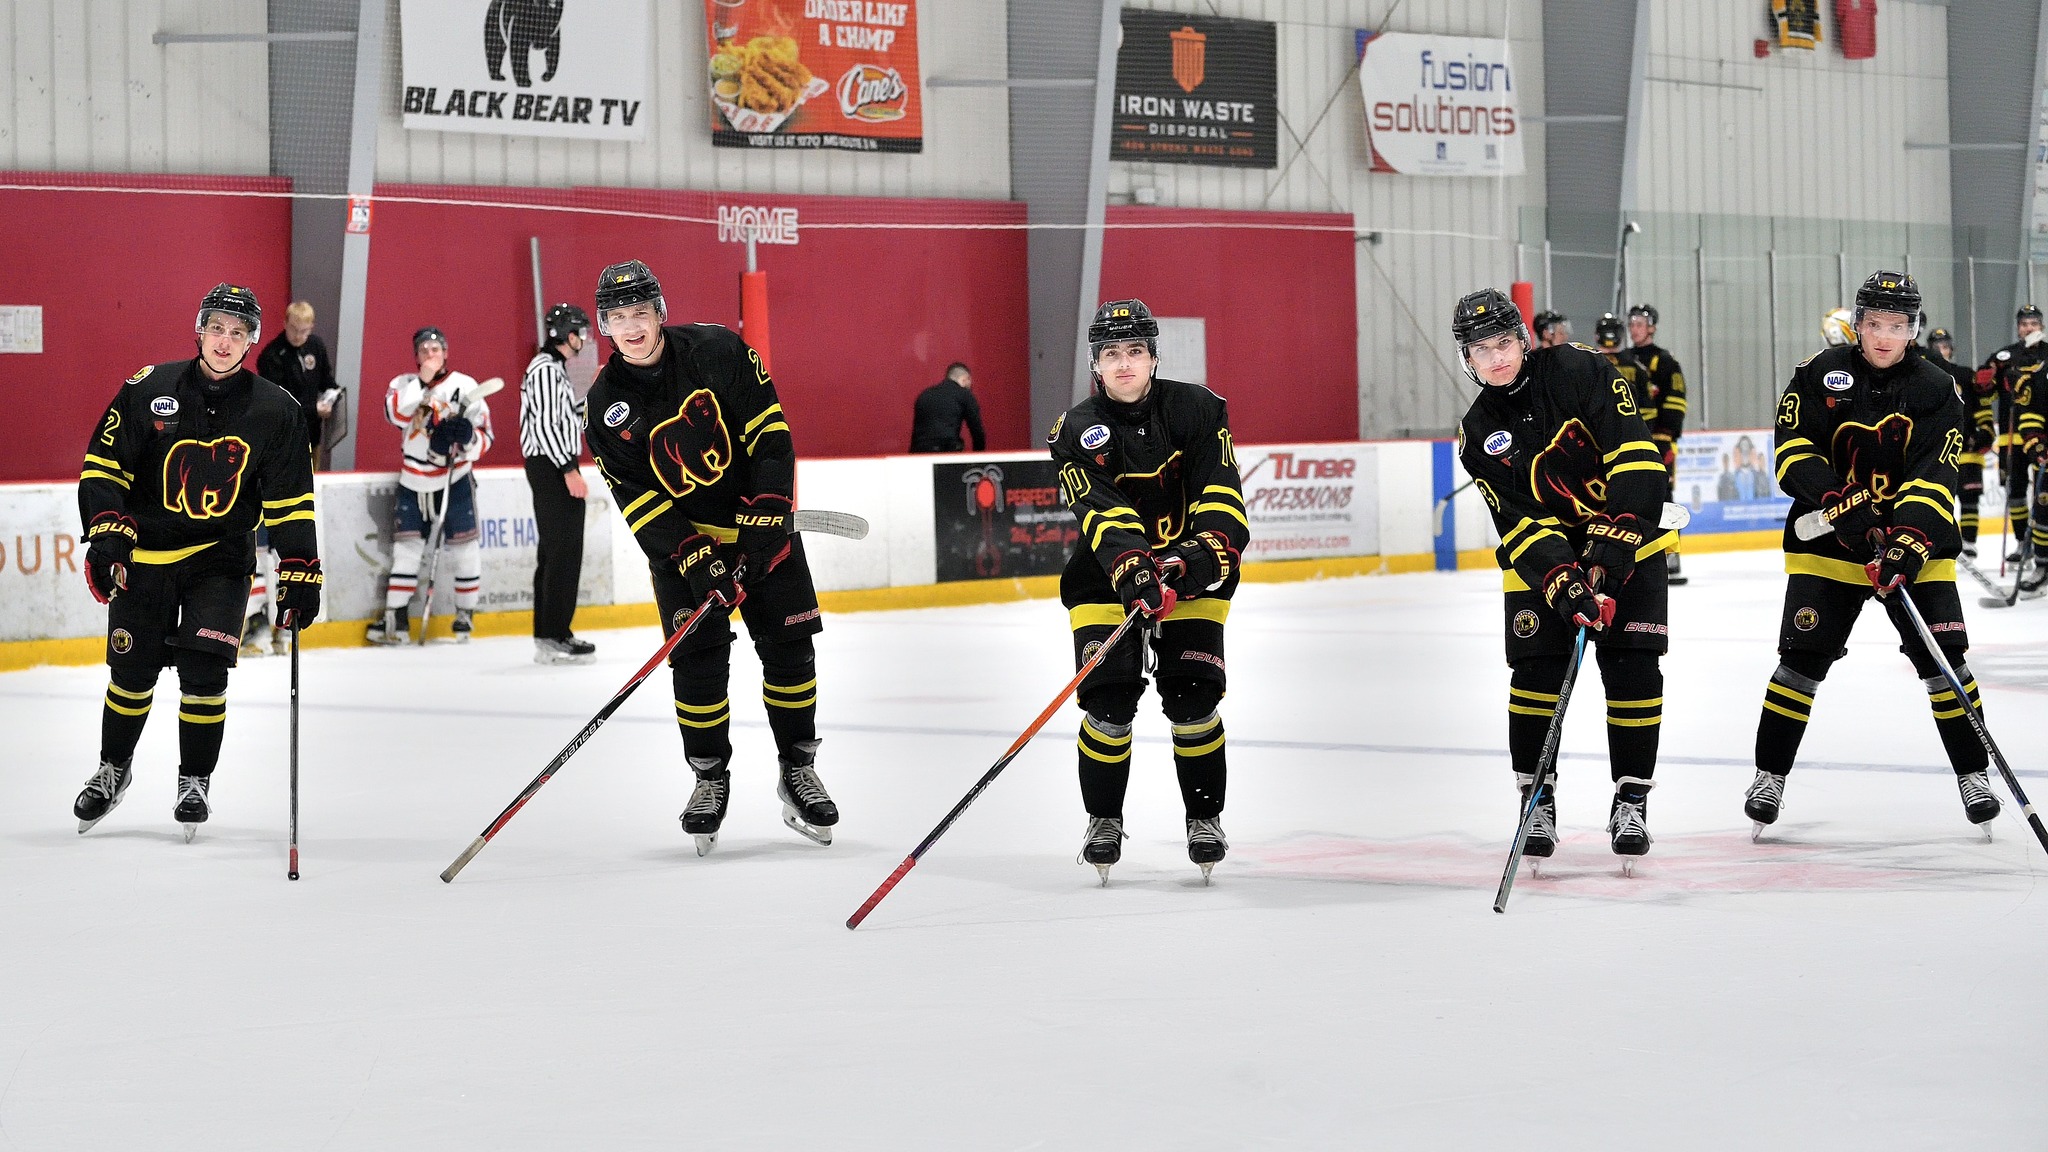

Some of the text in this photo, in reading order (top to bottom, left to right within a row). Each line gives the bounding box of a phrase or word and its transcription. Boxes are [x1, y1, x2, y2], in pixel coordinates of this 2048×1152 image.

[865, 2, 908, 26] LIKE
[819, 24, 896, 52] A CHAMP
[1421, 50, 1510, 92] fusion
[842, 64, 904, 116] Cane's
[404, 86, 641, 126] BLACK BEAR TV
[1120, 94, 1254, 123] IRON WASTE
[1374, 94, 1516, 136] solutions
[1149, 123, 1228, 139] DISPOSAL
[718, 206, 798, 245] HOME
[1881, 280, 1896, 289] 13
[1112, 308, 1129, 318] 10
[1476, 305, 1486, 314] 3
[748, 348, 771, 385] 2
[1827, 376, 1850, 386] NAHL
[450, 388, 460, 402] A
[1612, 378, 1636, 416] 3
[154, 402, 176, 412] NAHL
[606, 404, 628, 425] NAHL
[100, 408, 121, 446] 2
[1083, 428, 1108, 445] NAHL
[1486, 434, 1511, 452] NAHL
[1006, 488, 1058, 506] PERFECT
[736, 514, 784, 527] AUER
[514, 518, 536, 546] HA
[1196, 532, 1230, 581] BAUE
[280, 571, 322, 584] BAUE
[785, 608, 820, 626] BAUE
[1624, 622, 1668, 635] BAUE
[1929, 621, 1966, 633] AUER
[561, 722, 597, 763] BAUER
